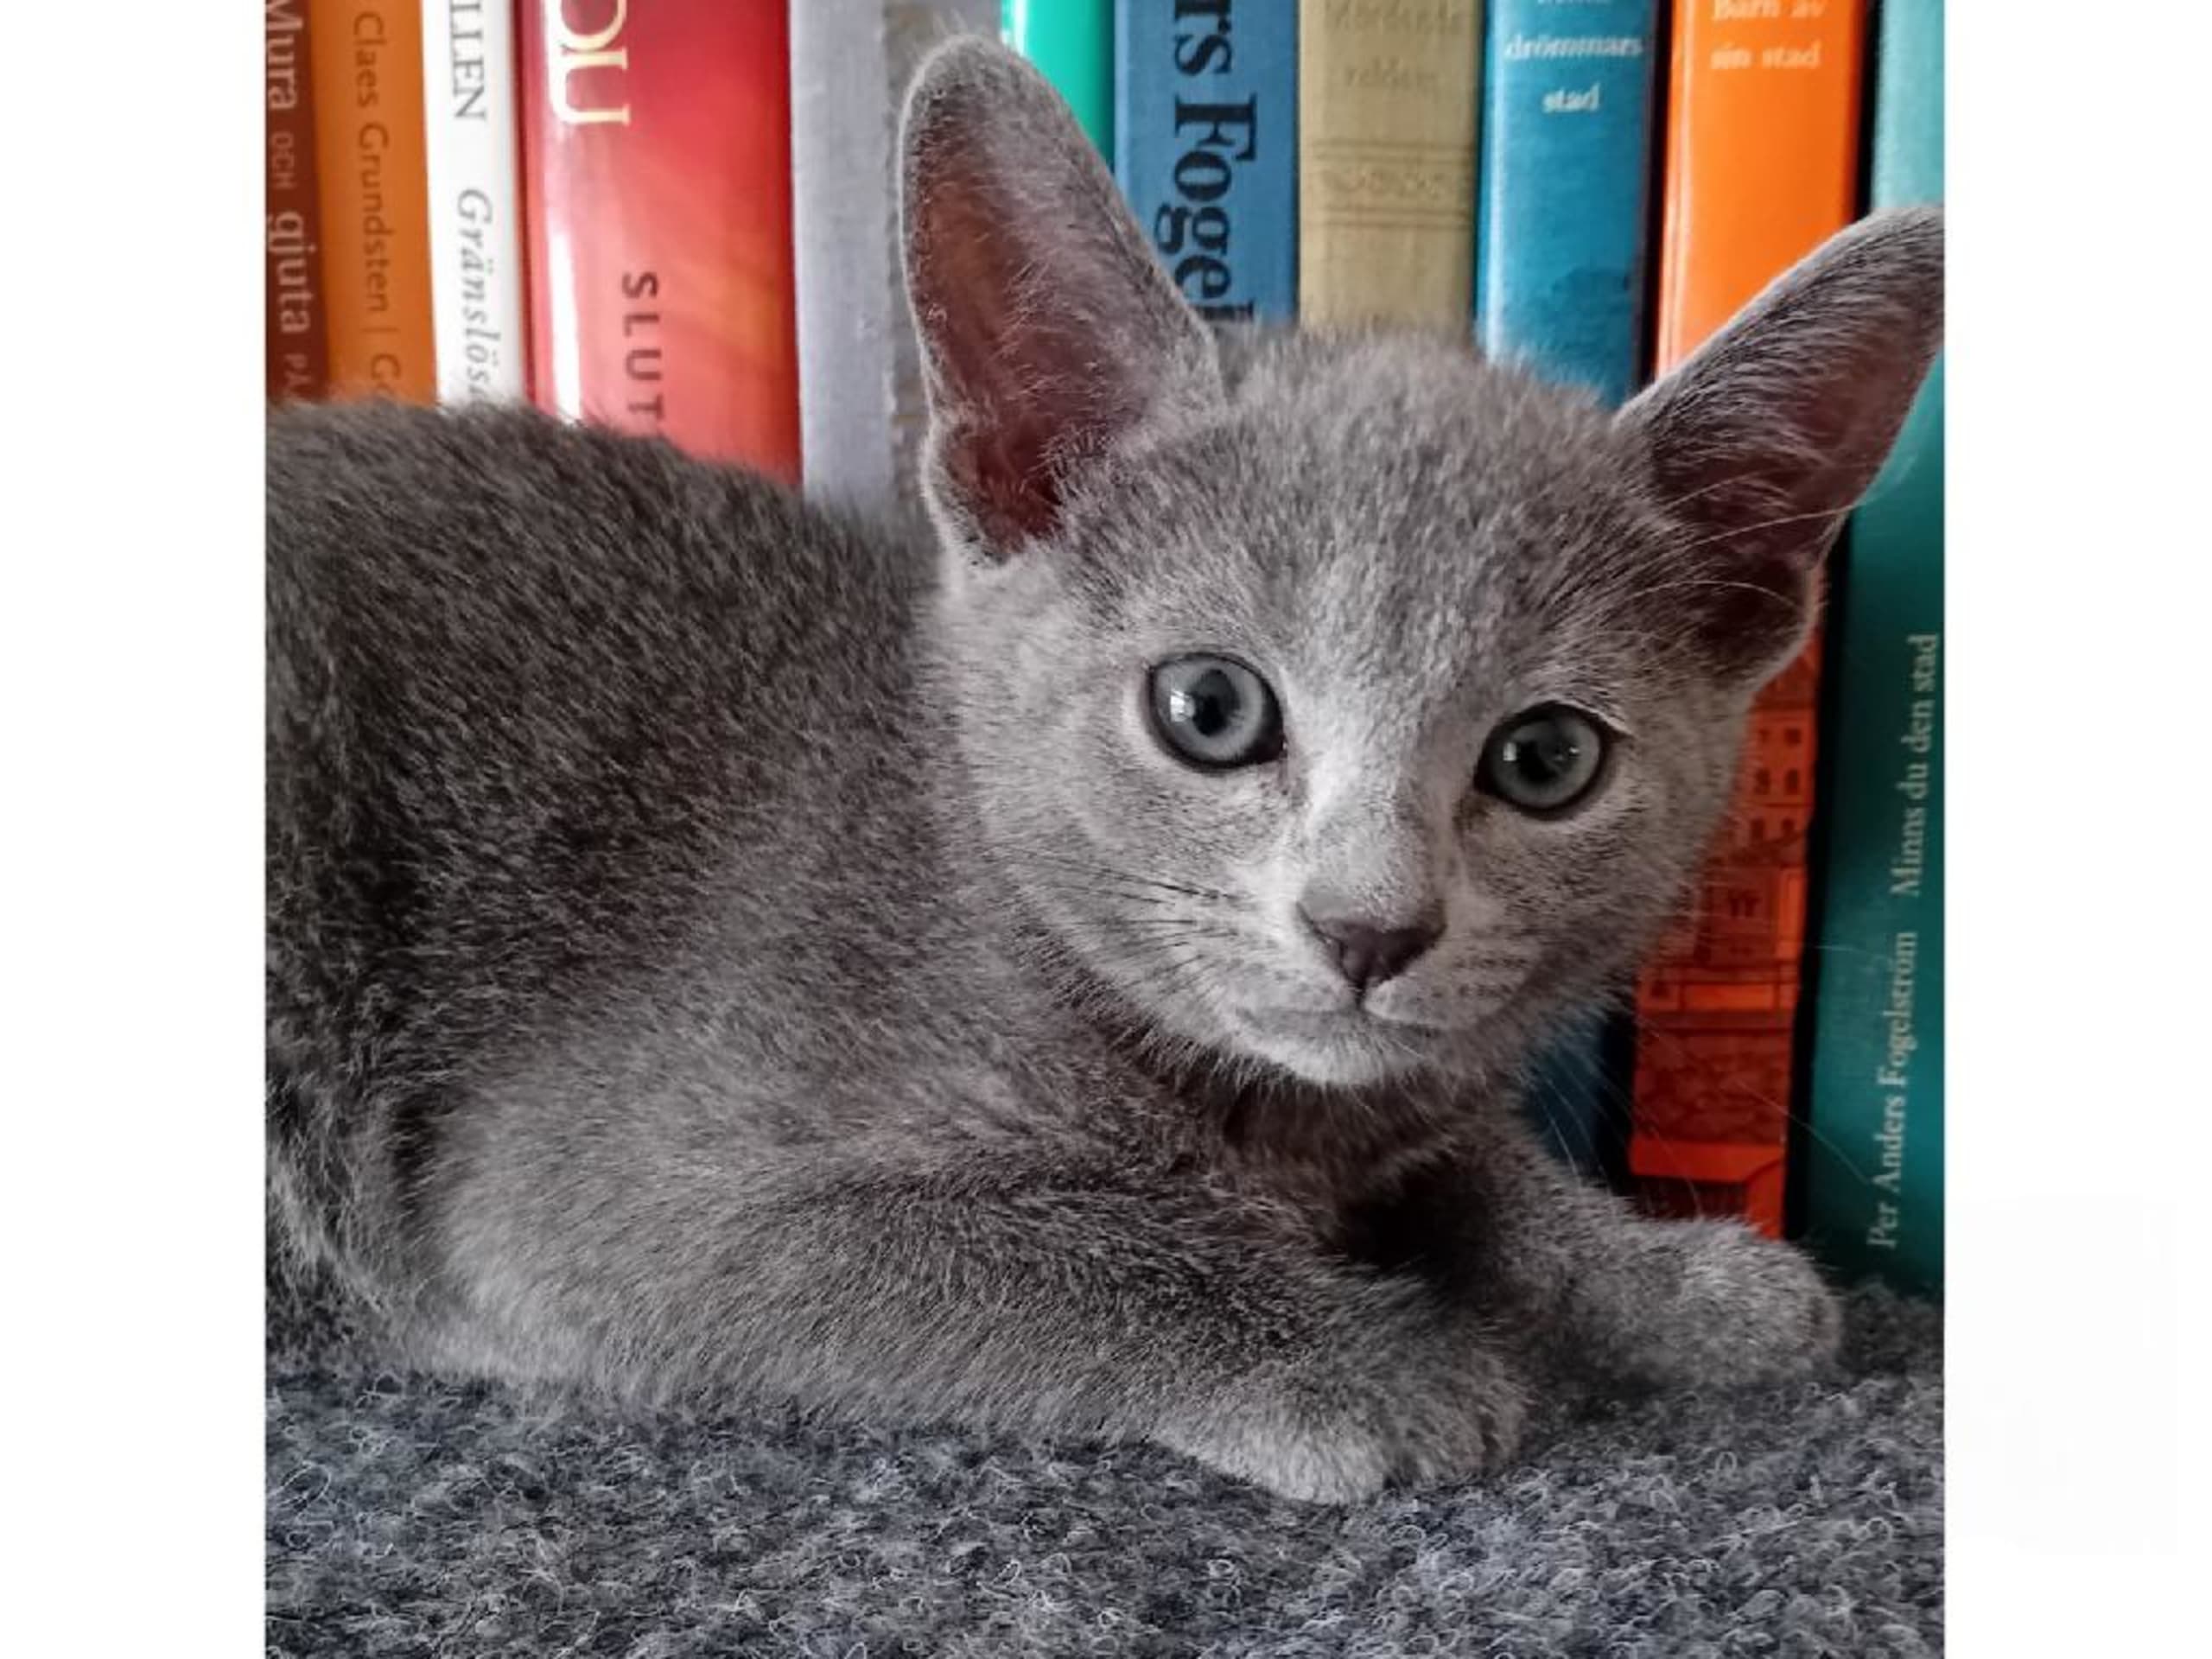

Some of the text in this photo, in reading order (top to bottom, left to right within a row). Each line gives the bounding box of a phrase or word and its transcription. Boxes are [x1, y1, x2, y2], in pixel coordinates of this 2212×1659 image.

[266, 0, 303, 110] Mura
[353, 10, 388, 109] Claes
[1541, 81, 1600, 113] stad
[1761, 38, 1823, 70] stad
[270, 130, 296, 189] OCH
[266, 210, 316, 334] gjuta
[358, 121, 397, 314] Grundsten
[620, 270, 664, 422] SLUT
[1867, 633, 1939, 1249] Per Anders Fogelström Minns du den stad
